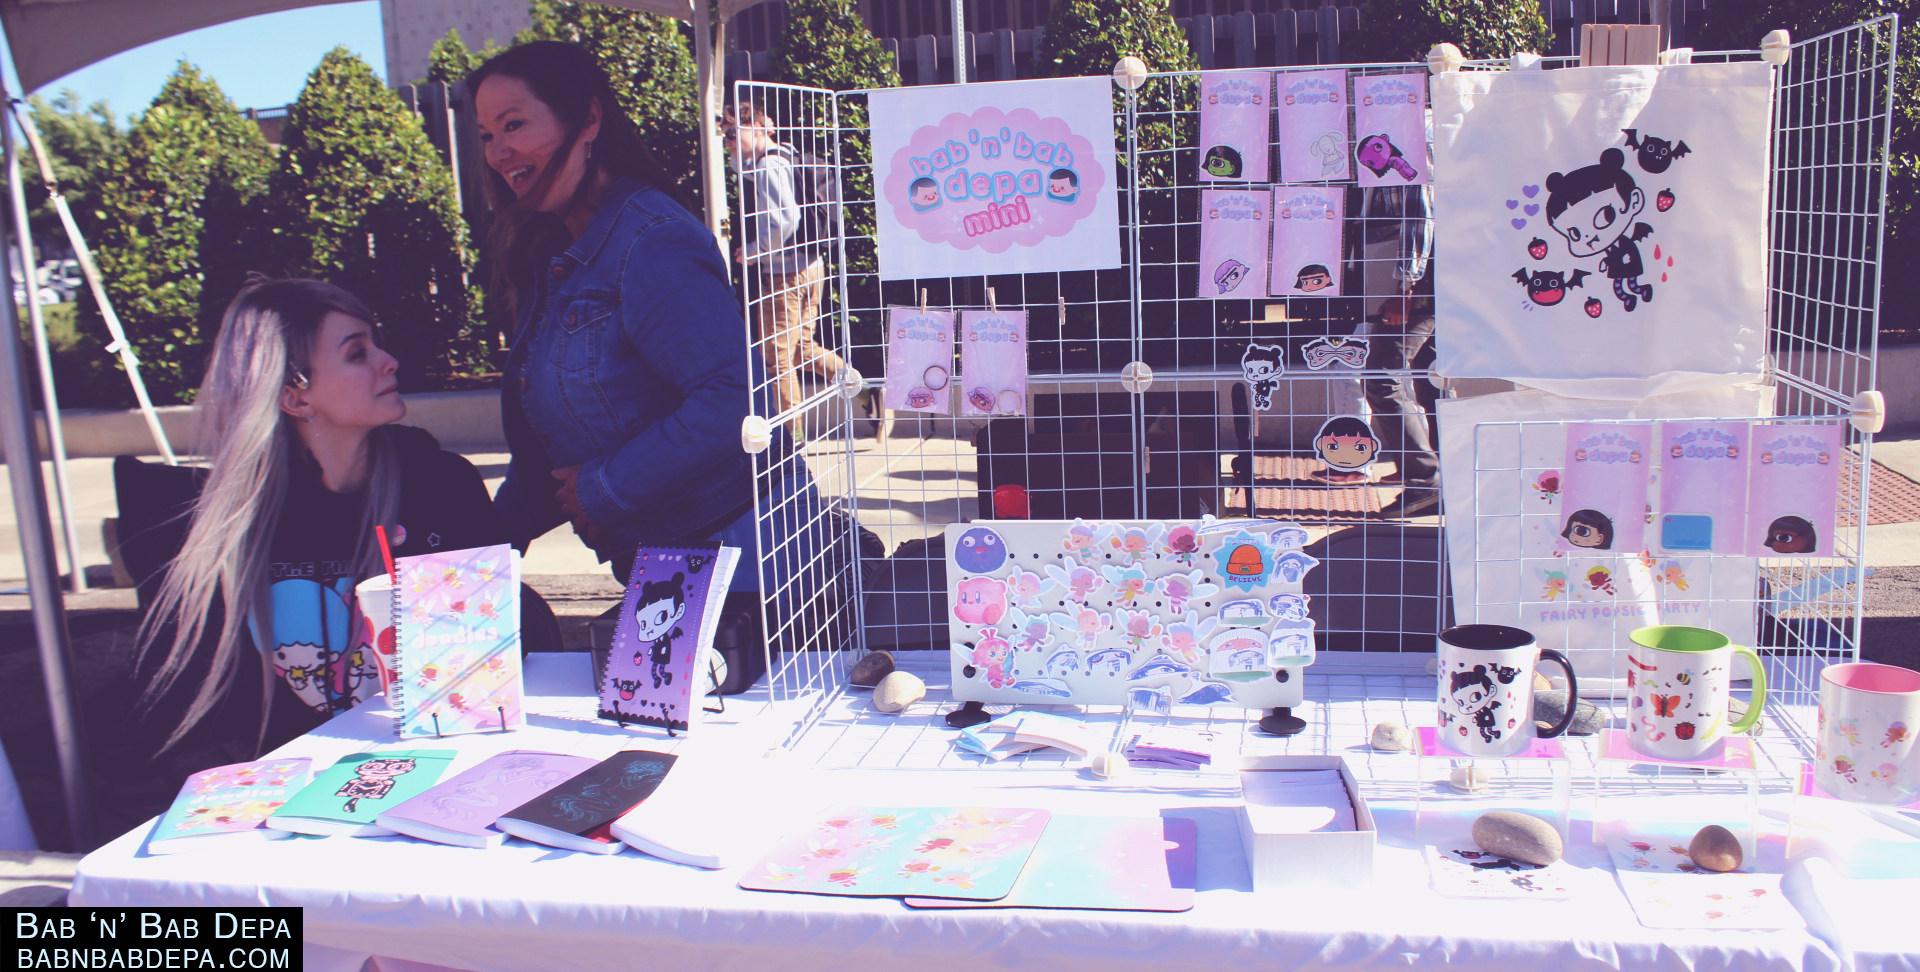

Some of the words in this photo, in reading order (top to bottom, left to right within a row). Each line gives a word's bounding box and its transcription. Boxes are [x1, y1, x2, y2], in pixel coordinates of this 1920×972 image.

[909, 139, 969, 177] bab
[1013, 131, 1074, 169] bab
[944, 167, 1043, 204] depa
[963, 195, 1031, 237] mini
[1229, 575, 1262, 583] BELIEVE
[1540, 608, 1586, 622] FAIRY
[1592, 604, 1646, 619] POPSIC
[411, 625, 498, 650] doodles
